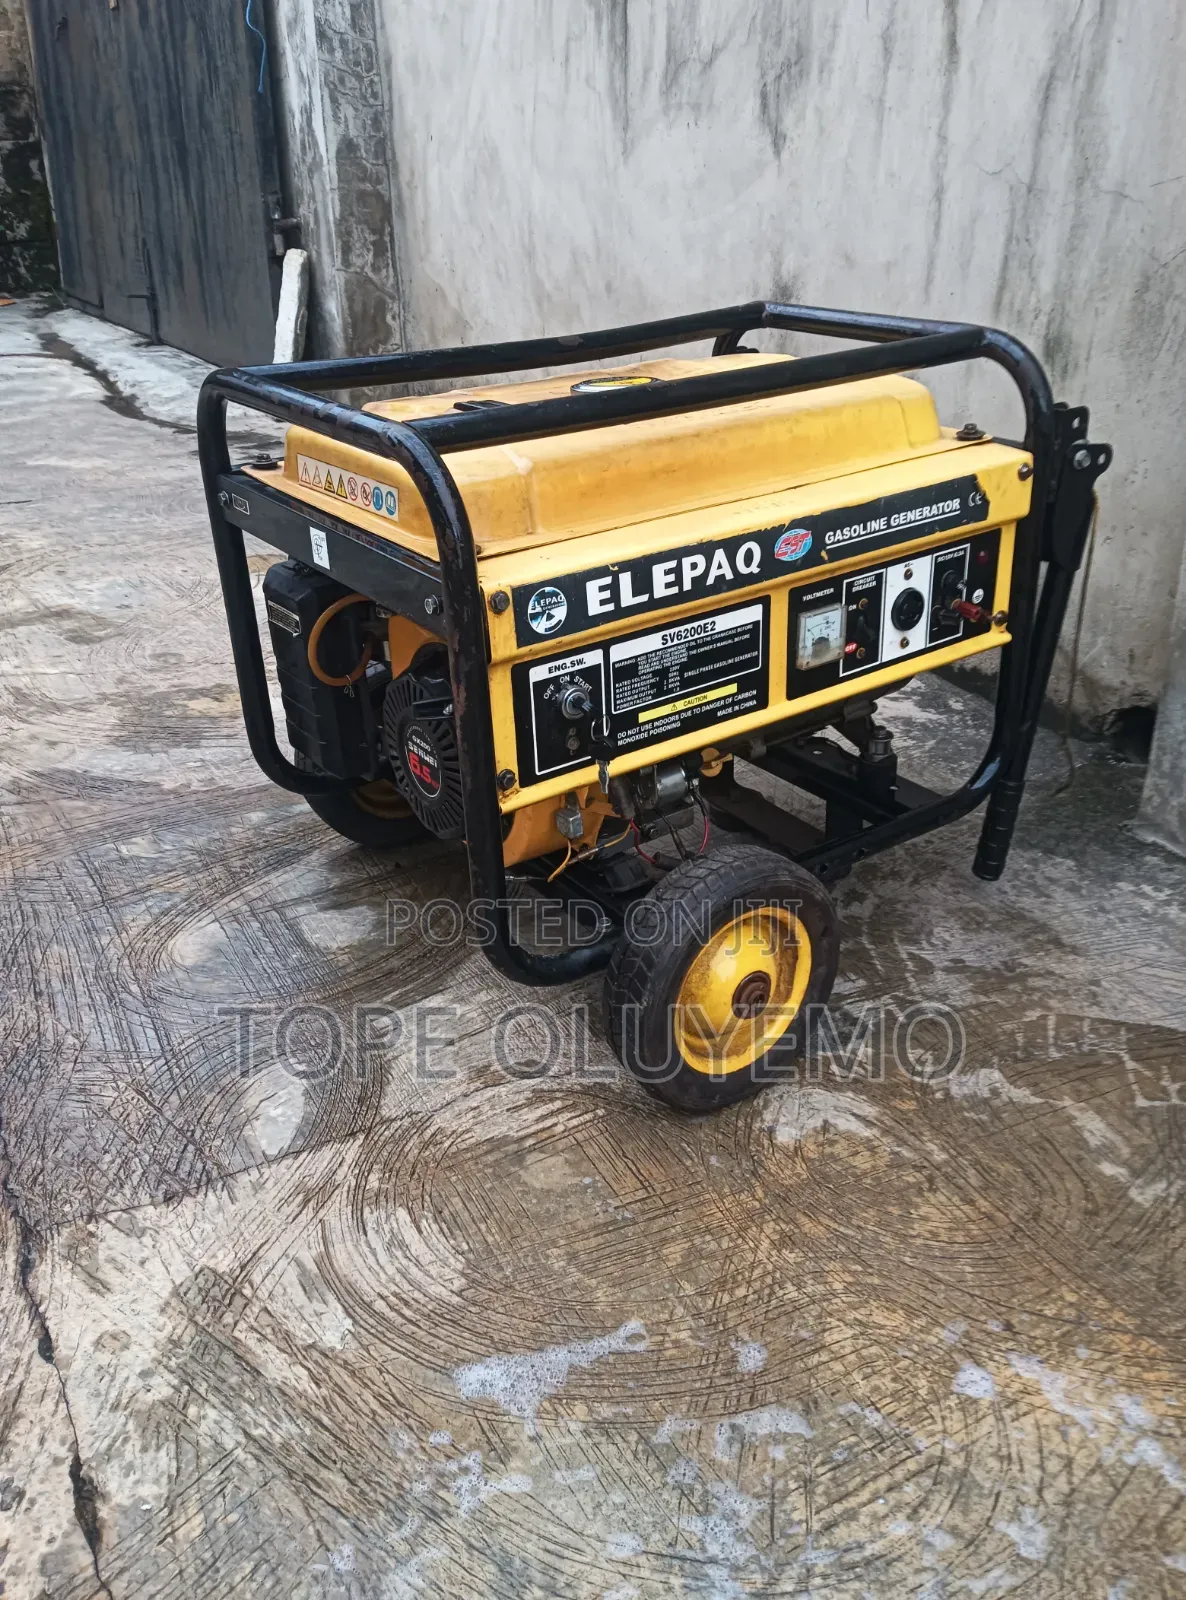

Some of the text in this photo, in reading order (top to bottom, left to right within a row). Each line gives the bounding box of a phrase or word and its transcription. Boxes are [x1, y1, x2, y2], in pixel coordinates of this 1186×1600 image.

[825, 498, 960, 545] GASOLINE GENERATOR
[586, 540, 762, 617] ELEPAQ
[852, 581, 876, 592] BREAKER
[854, 576, 876, 586] CIRCUIT
[530, 595, 565, 610] ELEPAQ
[803, 588, 834, 601] VOLTMETER
[661, 621, 716, 646] SV6200E2
[712, 629, 736, 640] CRANKCASE
[737, 624, 753, 633] BEFORE
[734, 634, 750, 642] BEFORE
[845, 643, 857, 653] OFF
[548, 658, 586, 674] ENG.SW.
[684, 651, 758, 678] SINGLE PHASE GASOLINE GENERATOR
[560, 675, 570, 683] ON
[574, 675, 592, 692] START
[632, 673, 652, 682] VOLTAGE
[632, 677, 659, 688] FREQUENCY
[543, 684, 555, 700] OFF
[616, 691, 631, 699] RATED
[632, 685, 650, 693] OUTPUT
[616, 695, 638, 704] MAXIMUM
[639, 688, 657, 697] OUTPUT
[617, 701, 634, 710] POWER
[634, 696, 652, 705] FACTOR
[684, 695, 707, 707] CAUTION
[717, 708, 733, 717] MADE
[740, 699, 757, 710] CHINA
[628, 727, 640, 735] NOT
[641, 723, 652, 732] USE
[654, 715, 679, 728] INDOORS
[680, 710, 692, 719] DUE
[702, 699, 722, 712] DANGER
[723, 697, 732, 705] OF
[734, 689, 757, 703] CARBON
[618, 721, 681, 746] MONOXIDE POISONING
[412, 735, 431, 752] GX200
[409, 751, 432, 784] 6.5
